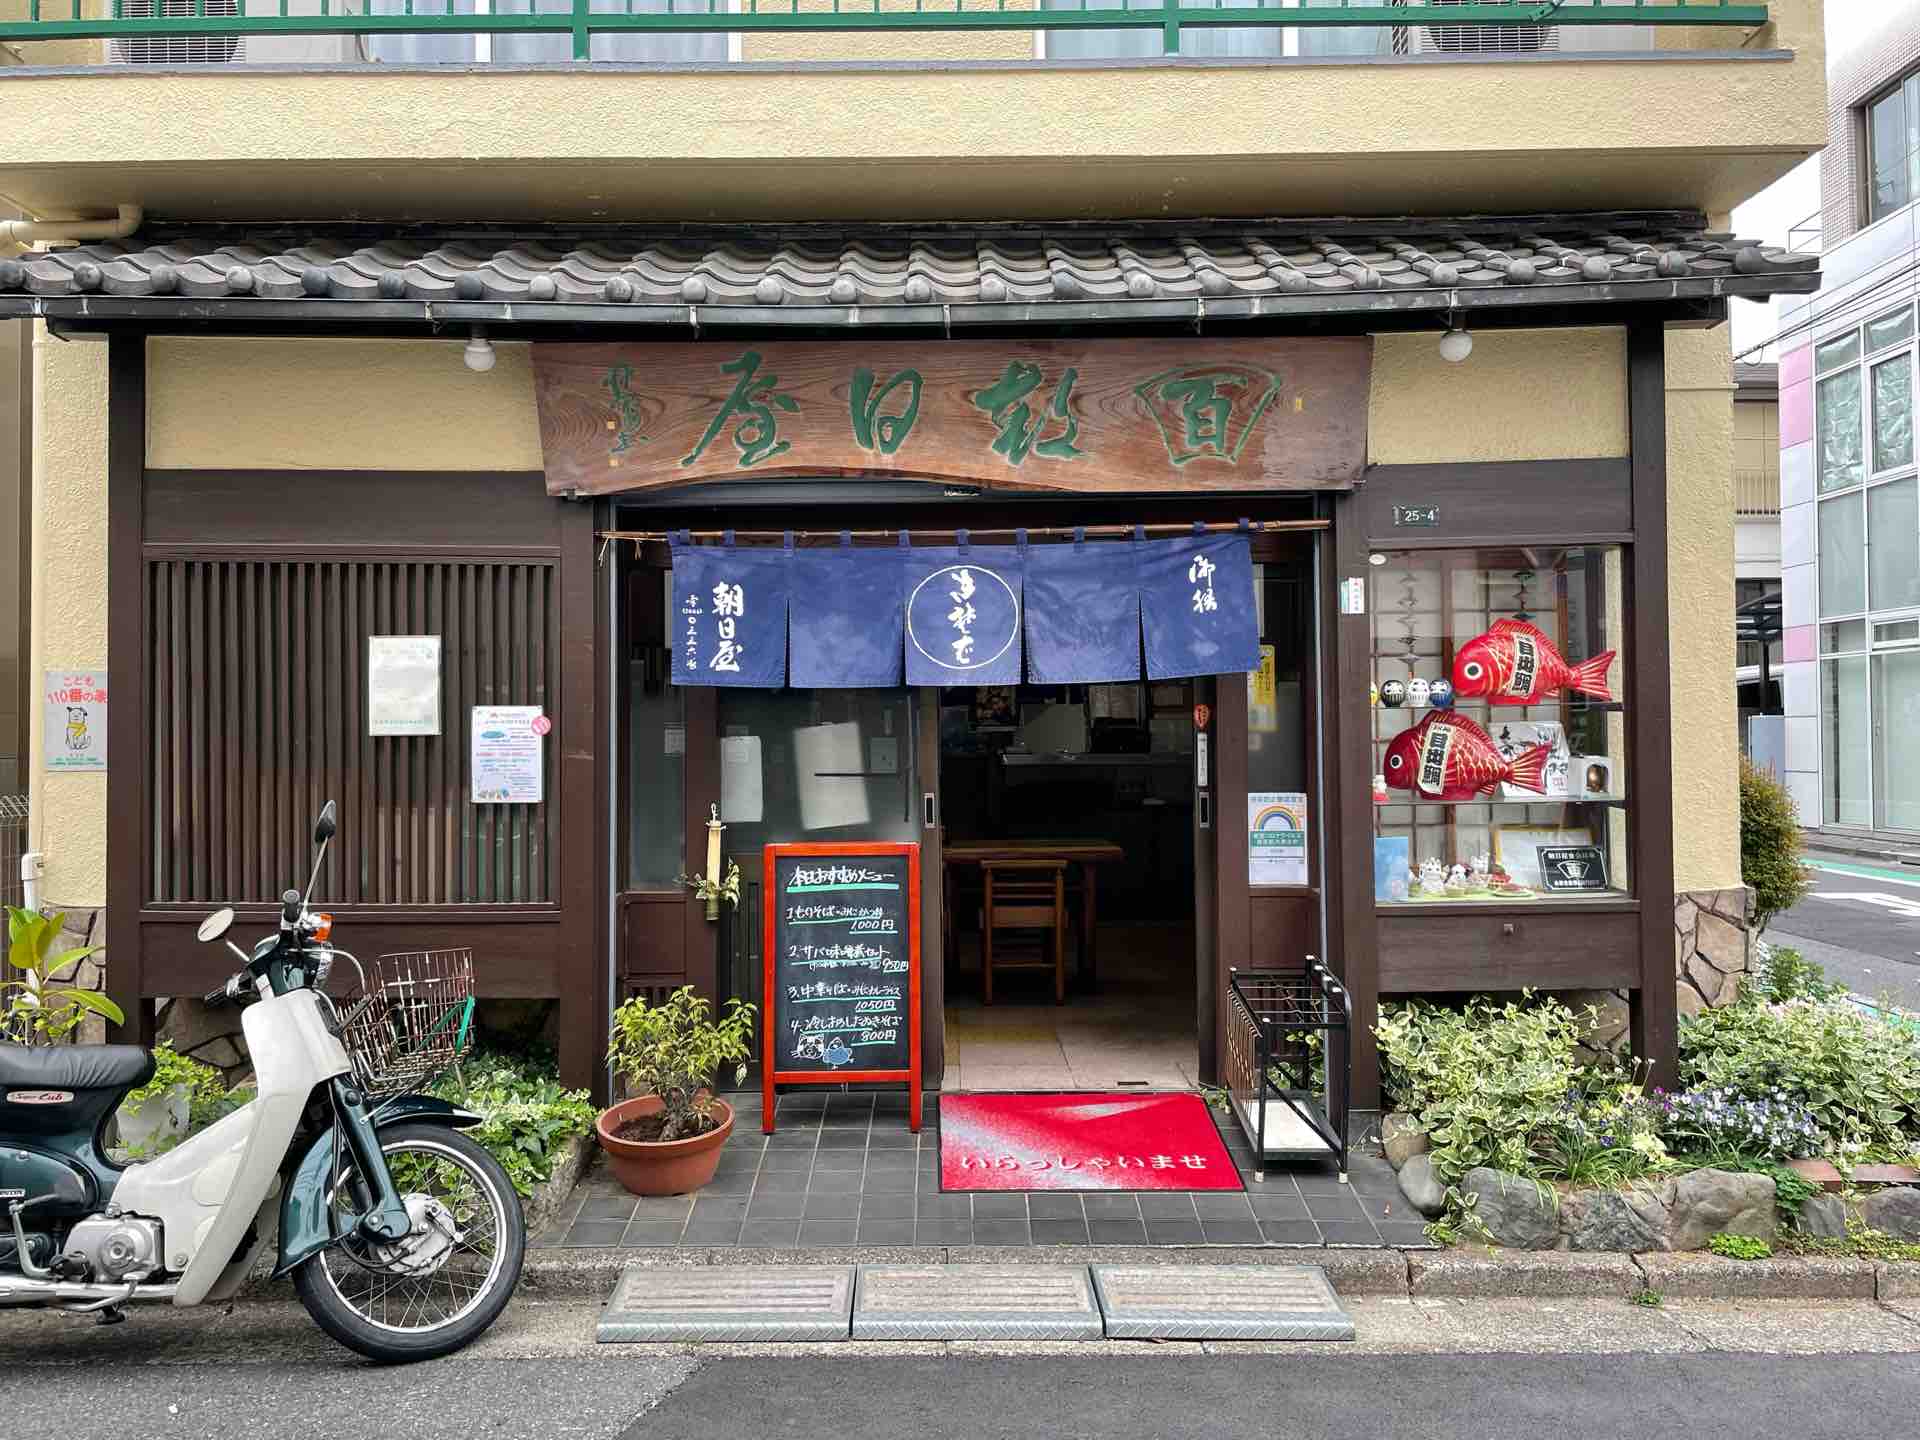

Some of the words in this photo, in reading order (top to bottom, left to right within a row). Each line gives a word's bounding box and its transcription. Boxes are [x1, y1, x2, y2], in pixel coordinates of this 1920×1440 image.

[1404, 509, 1435, 522] 25-4
[708, 581, 745, 673] 朝日屋
[63, 674, 96, 688] こども
[959, 1153, 1209, 1171] いらっしゃいませ
